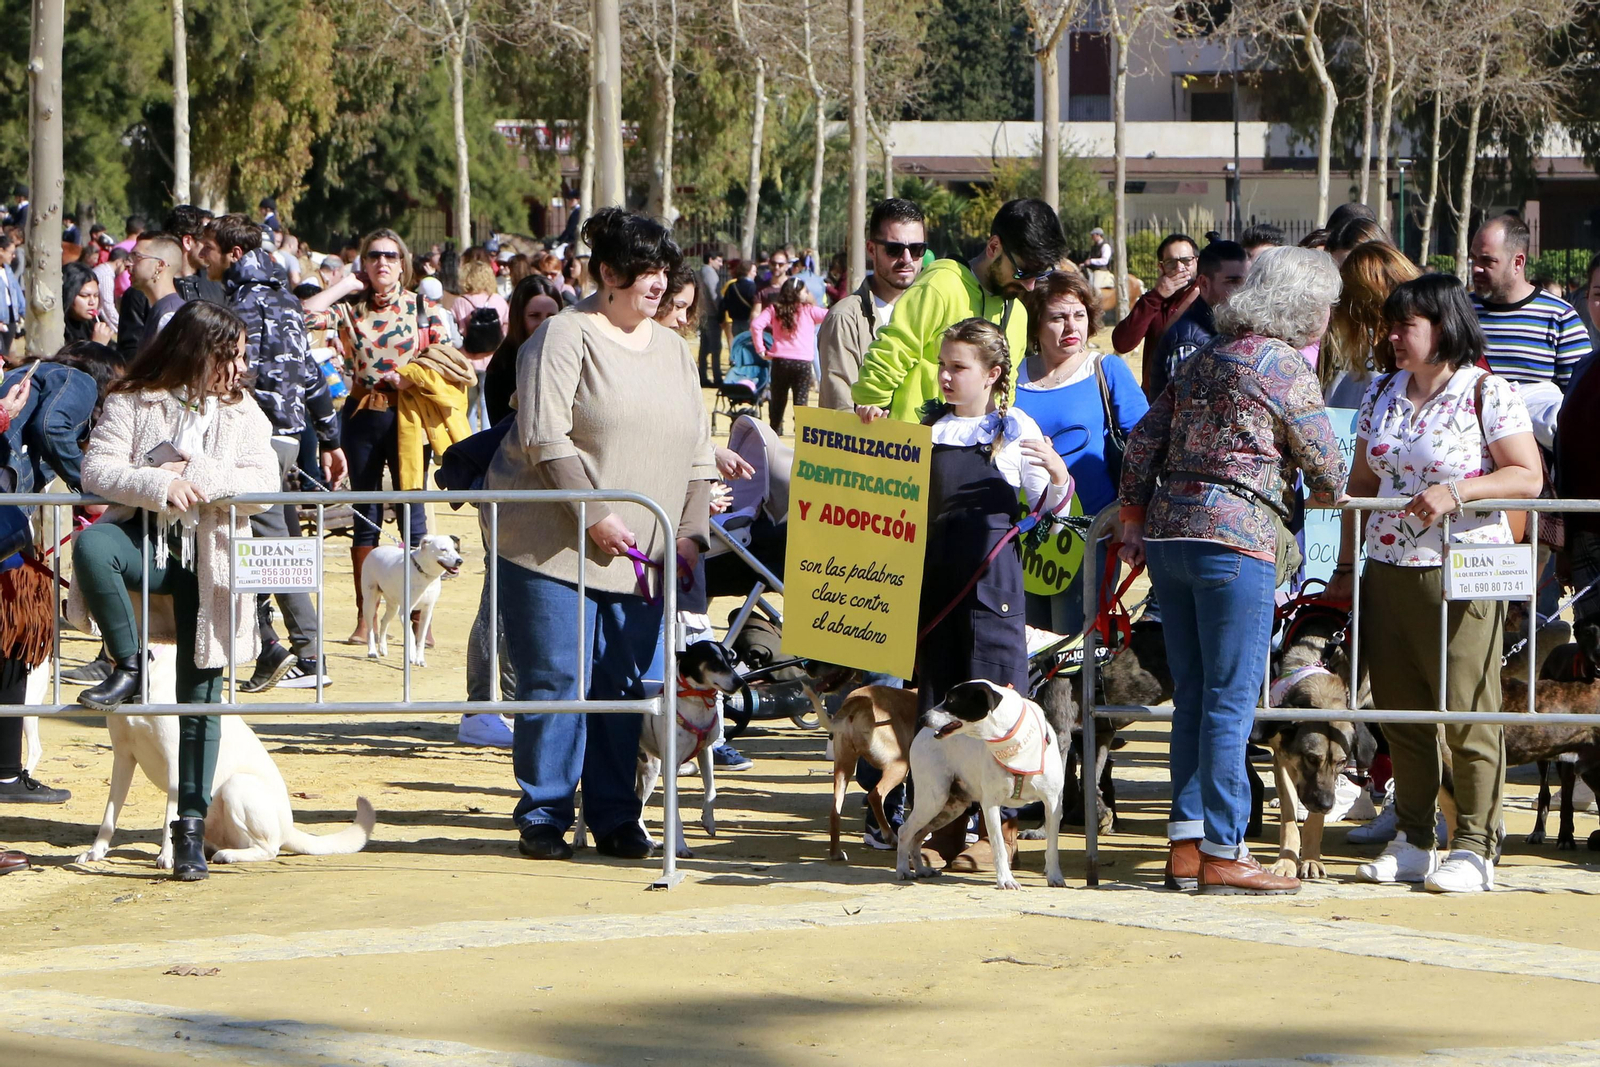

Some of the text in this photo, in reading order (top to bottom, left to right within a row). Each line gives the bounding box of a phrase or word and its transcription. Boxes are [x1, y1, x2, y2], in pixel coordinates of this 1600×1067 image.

[802, 426, 921, 463] ESTERILIZACIÓN
[797, 460, 920, 502] IDENTIFICACIÓN
[798, 499, 916, 543] Y ADOPCIÓN
[238, 543, 294, 556] DURÁN
[239, 557, 314, 567] ALQUILERES
[1453, 553, 1494, 569] DURÁN
[800, 556, 905, 586] son las palabras
[812, 582, 890, 614] clave contra
[1460, 581, 1523, 593] Tel. 690 80 73 41
[812, 610, 887, 644] el abandono
